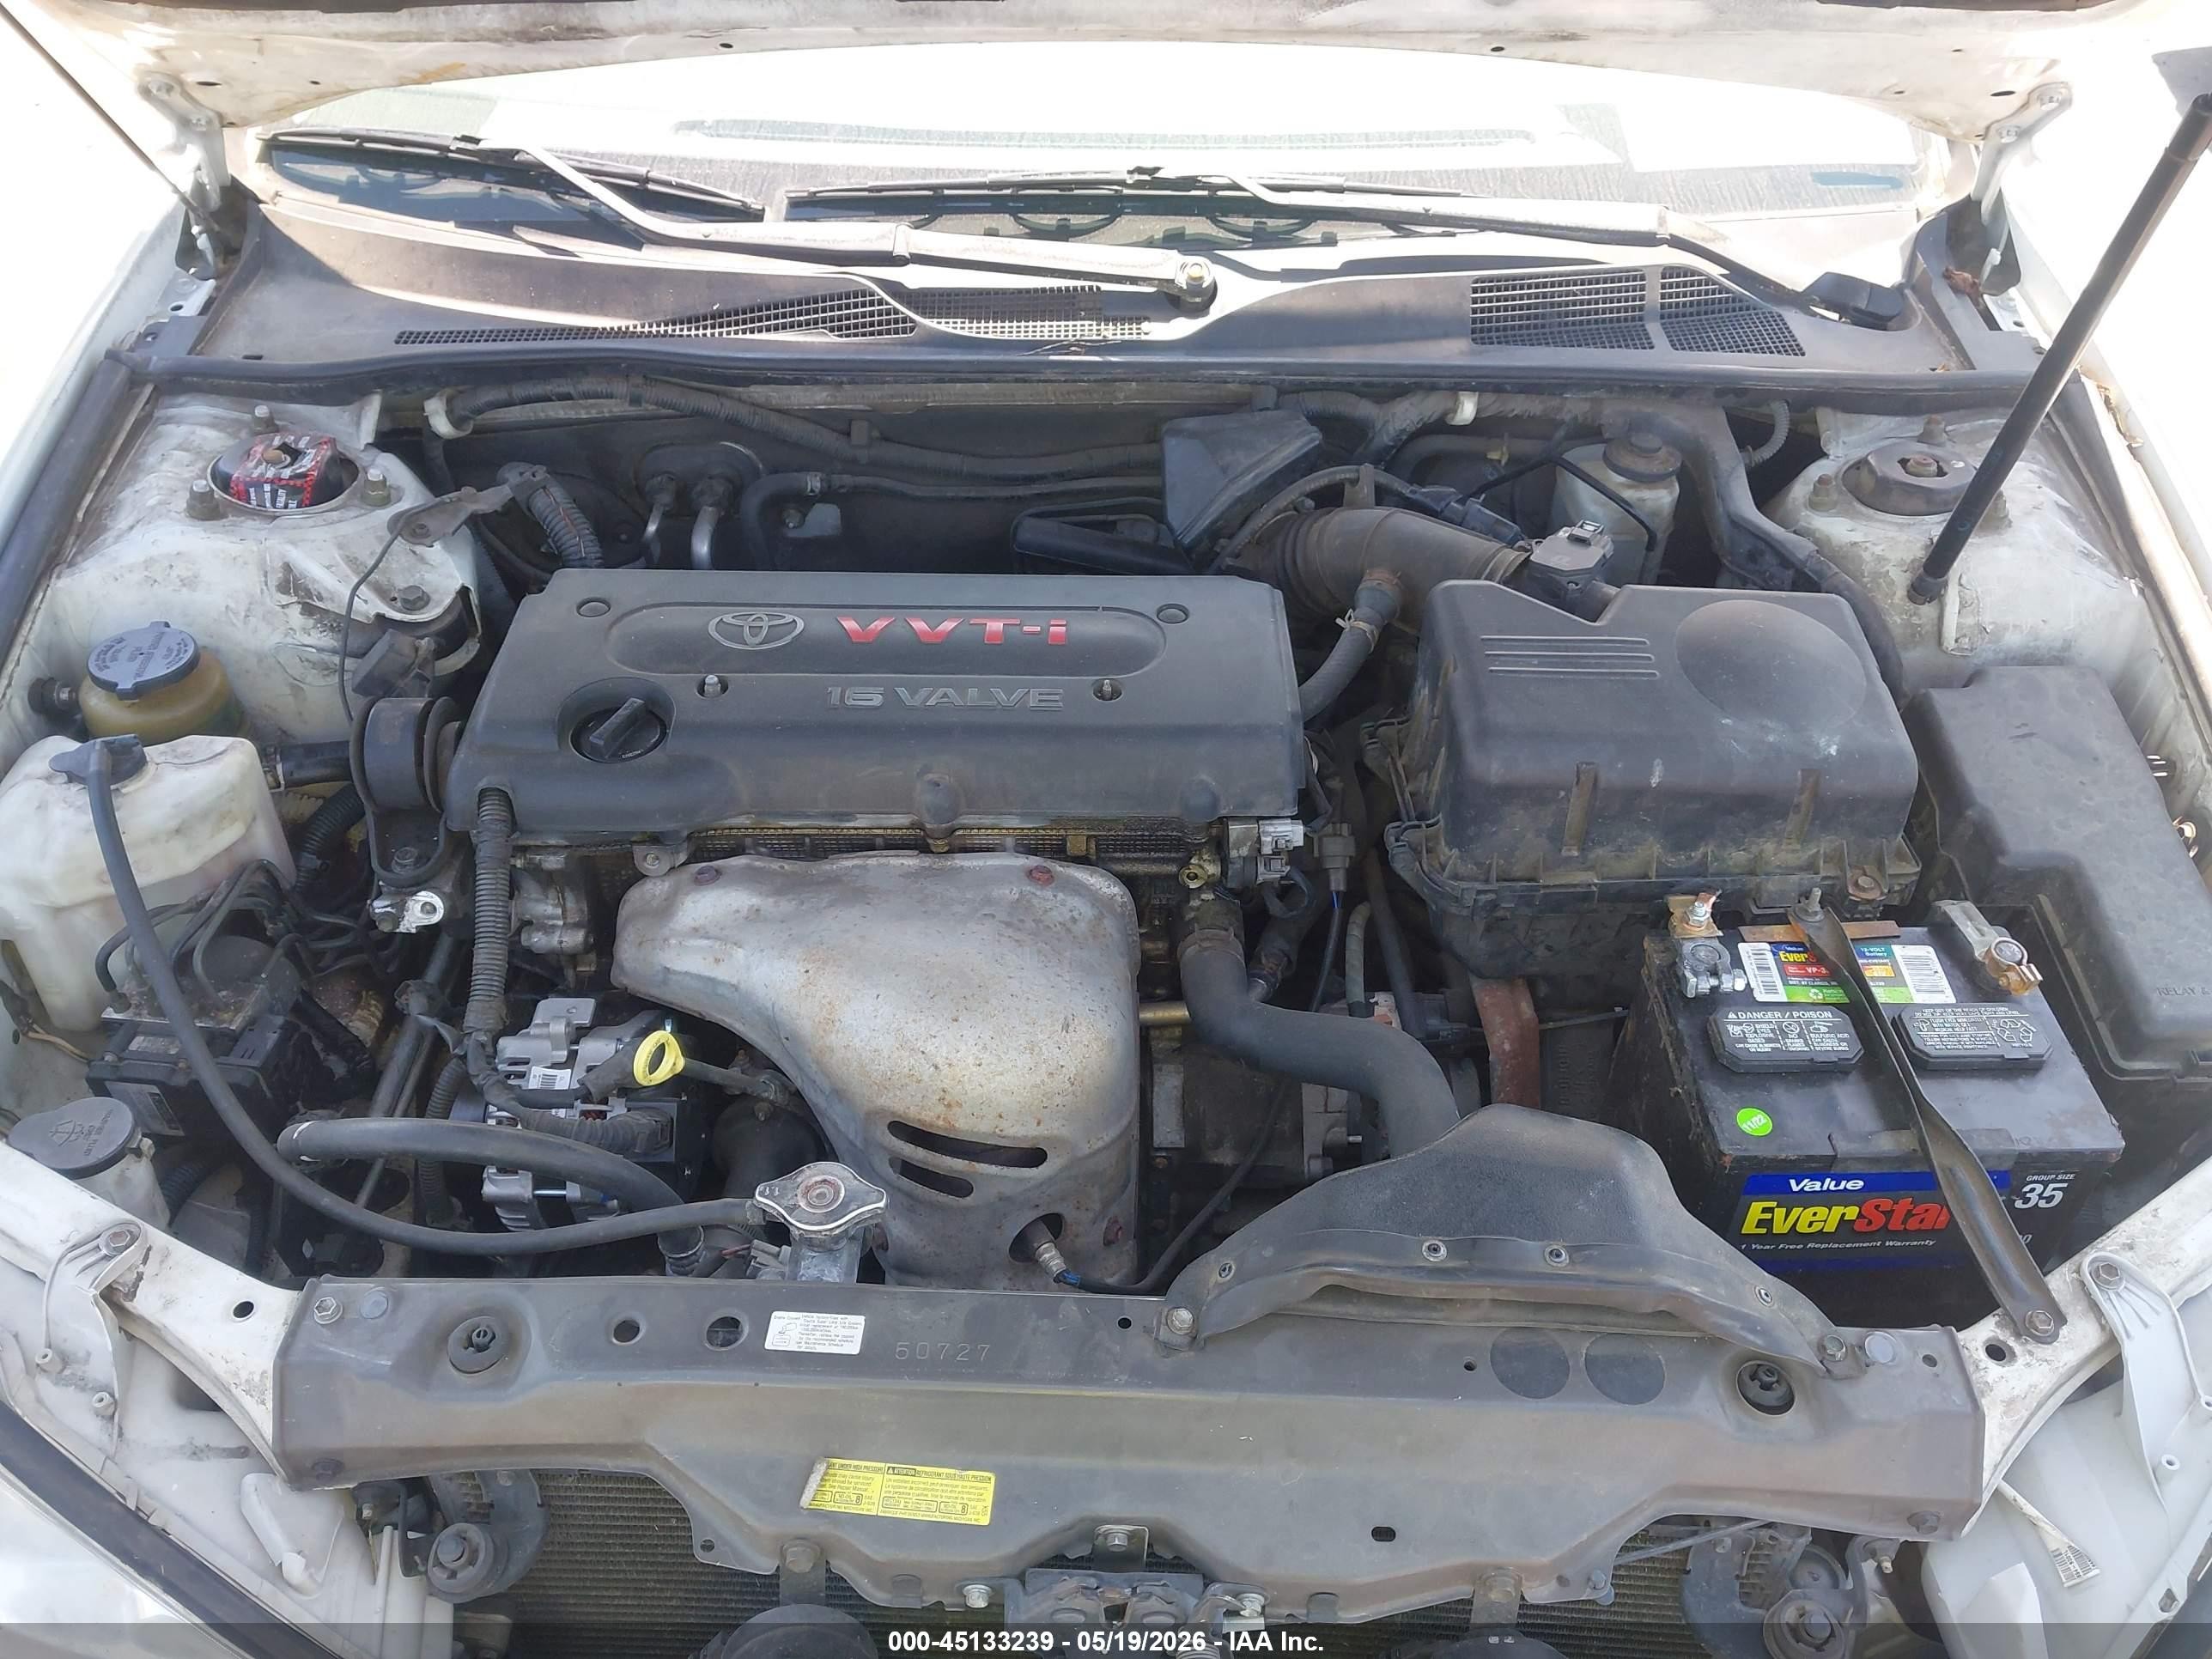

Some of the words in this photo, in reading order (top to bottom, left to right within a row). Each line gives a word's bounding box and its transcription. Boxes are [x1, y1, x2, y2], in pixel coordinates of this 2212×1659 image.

[836, 617, 1067, 645] VVT-i
[826, 687, 884, 708] 16
[893, 687, 1065, 711] VALVE
[1779, 951, 1817, 963] EverS
[1737, 1011, 1783, 1019] DANGER
[1789, 1177, 1865, 1192] Value
[2014, 1182, 2069, 1209] 35
[1807, 1241, 1881, 1249] Replacement
[855, 1495, 861, 1504] 8
[961, 1505, 966, 1514] 8
